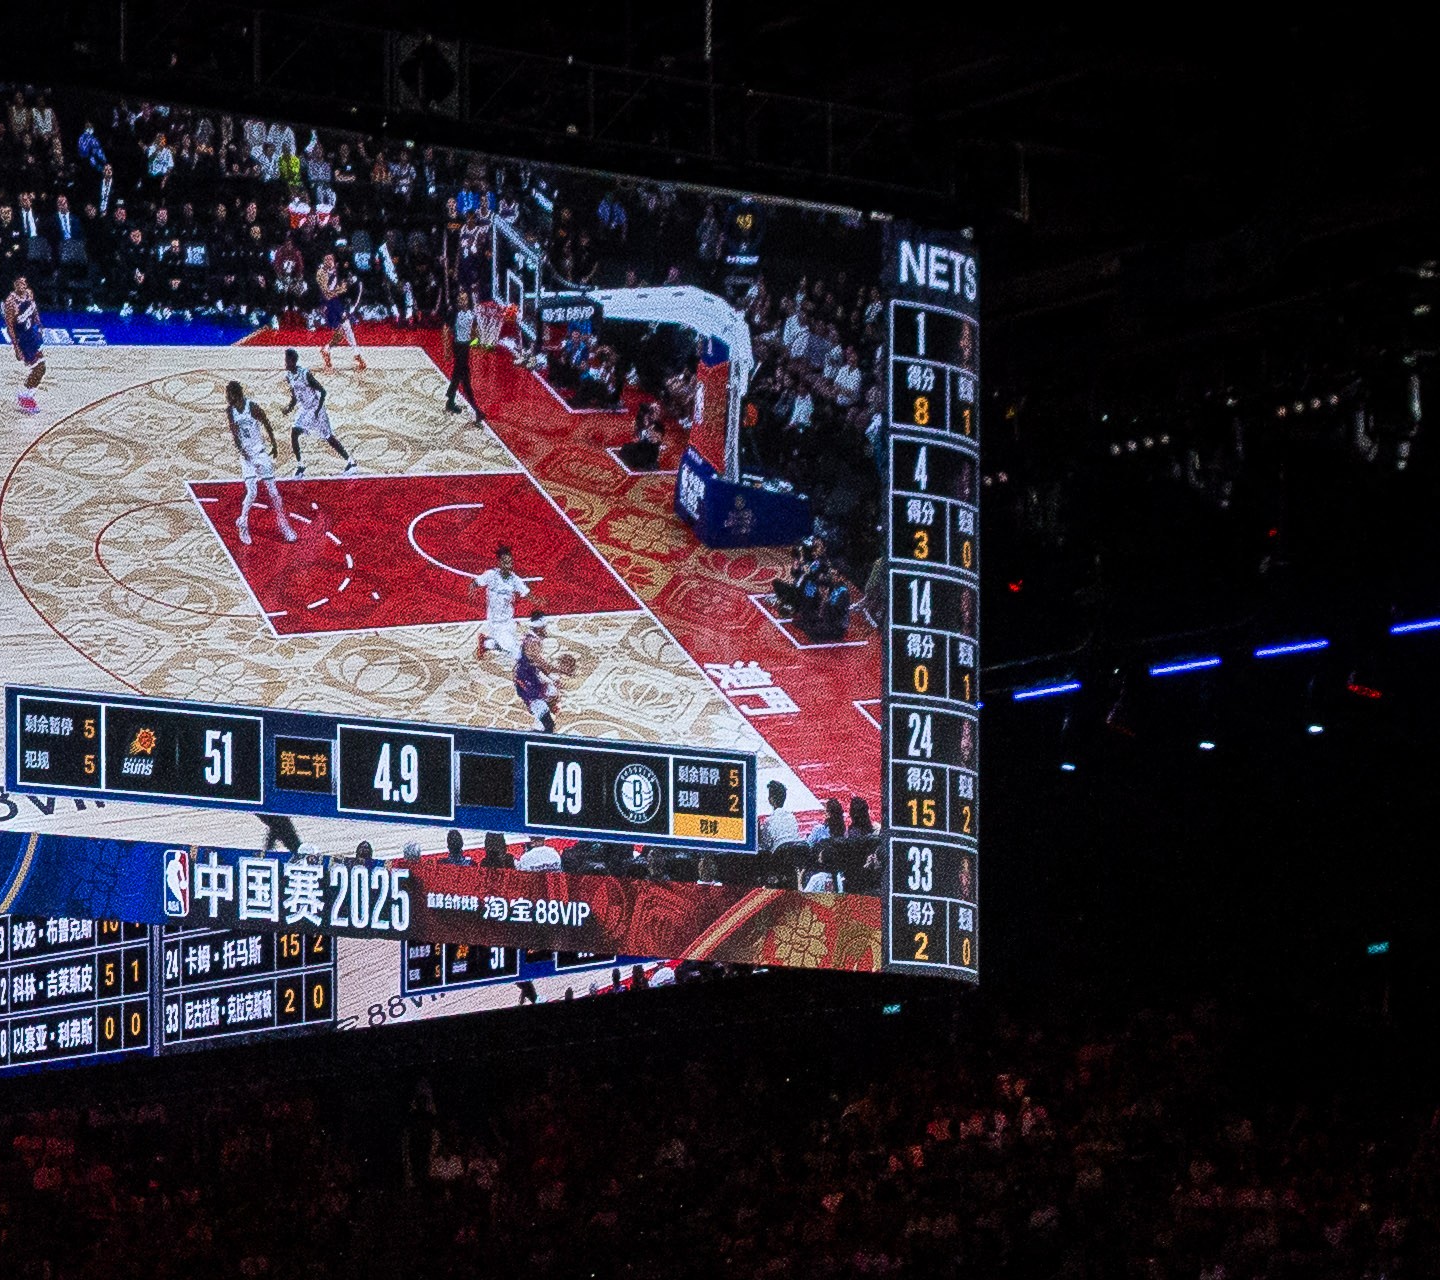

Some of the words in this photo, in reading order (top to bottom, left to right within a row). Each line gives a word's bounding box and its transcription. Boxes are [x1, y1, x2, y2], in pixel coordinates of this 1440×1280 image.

[899, 240, 976, 301] NETS
[908, 580, 931, 624] 14
[204, 730, 233, 786] 51
[908, 713, 933, 758] 24
[280, 750, 329, 779] 第二节
[373, 744, 418, 804] 4.9
[550, 761, 582, 815] 49
[194, 852, 410, 931] 中国赛2025
[908, 847, 933, 892] 33
[482, 896, 590, 927] 淘宝88VIP
